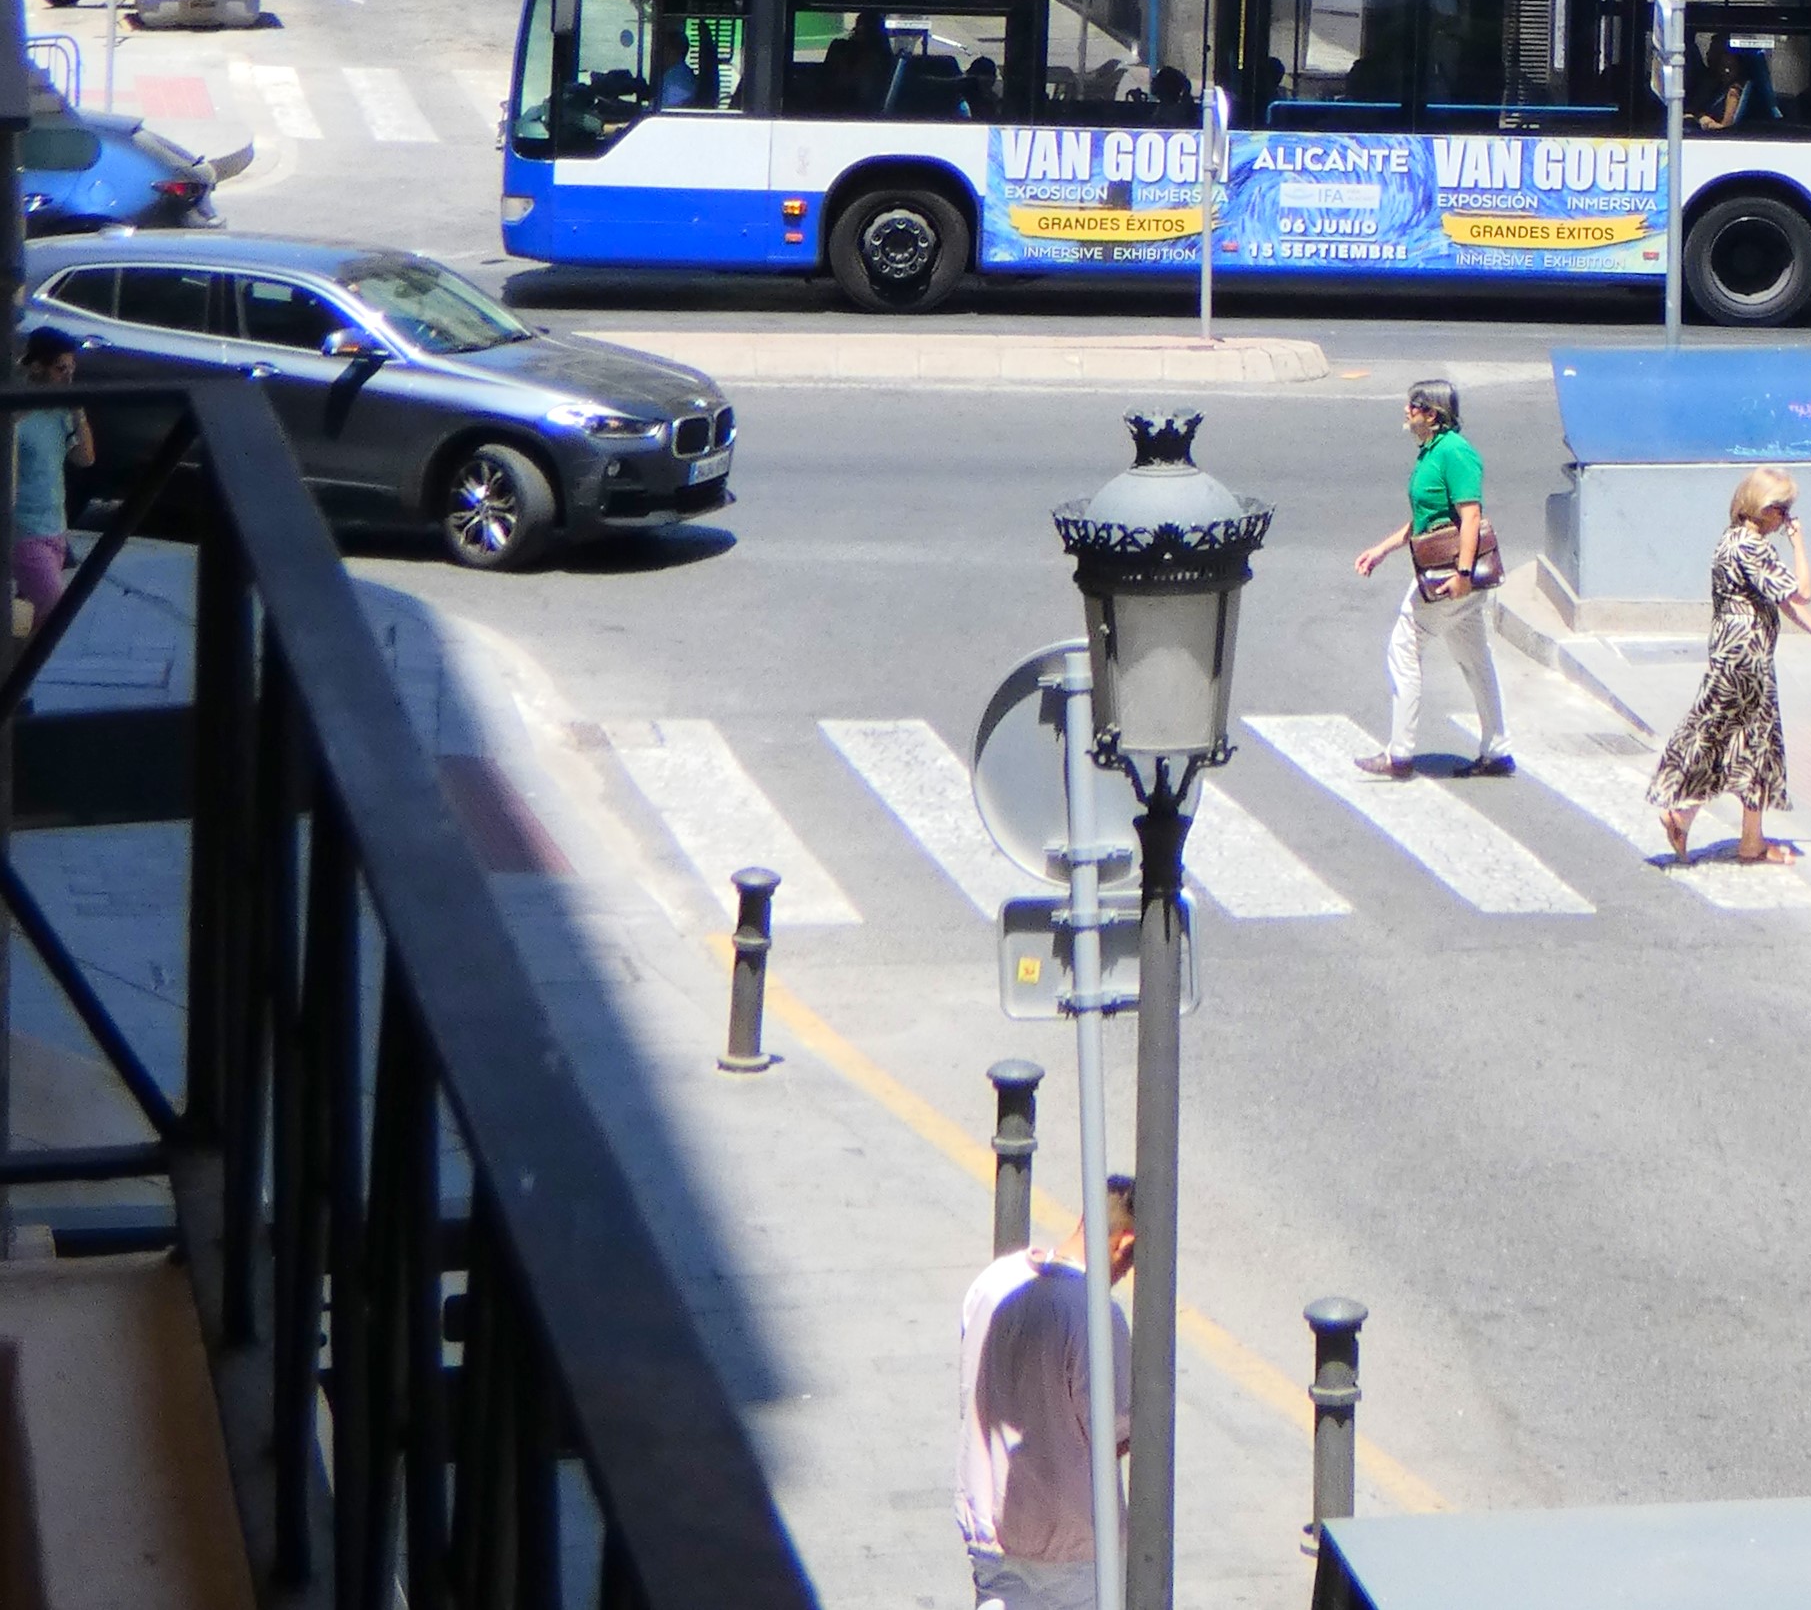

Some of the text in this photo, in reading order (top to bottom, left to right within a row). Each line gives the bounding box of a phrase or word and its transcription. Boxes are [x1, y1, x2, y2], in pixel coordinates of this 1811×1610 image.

[1001, 129, 1092, 180] VAN
[1252, 146, 1411, 174] ALICANTE
[1433, 139, 1658, 192] VAN GOGH
[1003, 181, 1109, 201] EXPOSICIÓN
[1317, 188, 1344, 204] IFA
[1437, 191, 1658, 211] EXPOSICIÓN INMERSIVA
[1036, 213, 1186, 233] GRANDES ÉXITOS
[1279, 218, 1378, 235] 06 JUNIO
[1469, 222, 1615, 241] GRANDES ÉXITOS
[1022, 245, 1197, 262] INMERSIVE EXHIBITION
[1249, 242, 1409, 261] 15 SEPTIEMBRE
[1455, 252, 1627, 270] INMERSIVE EXHIBITION
